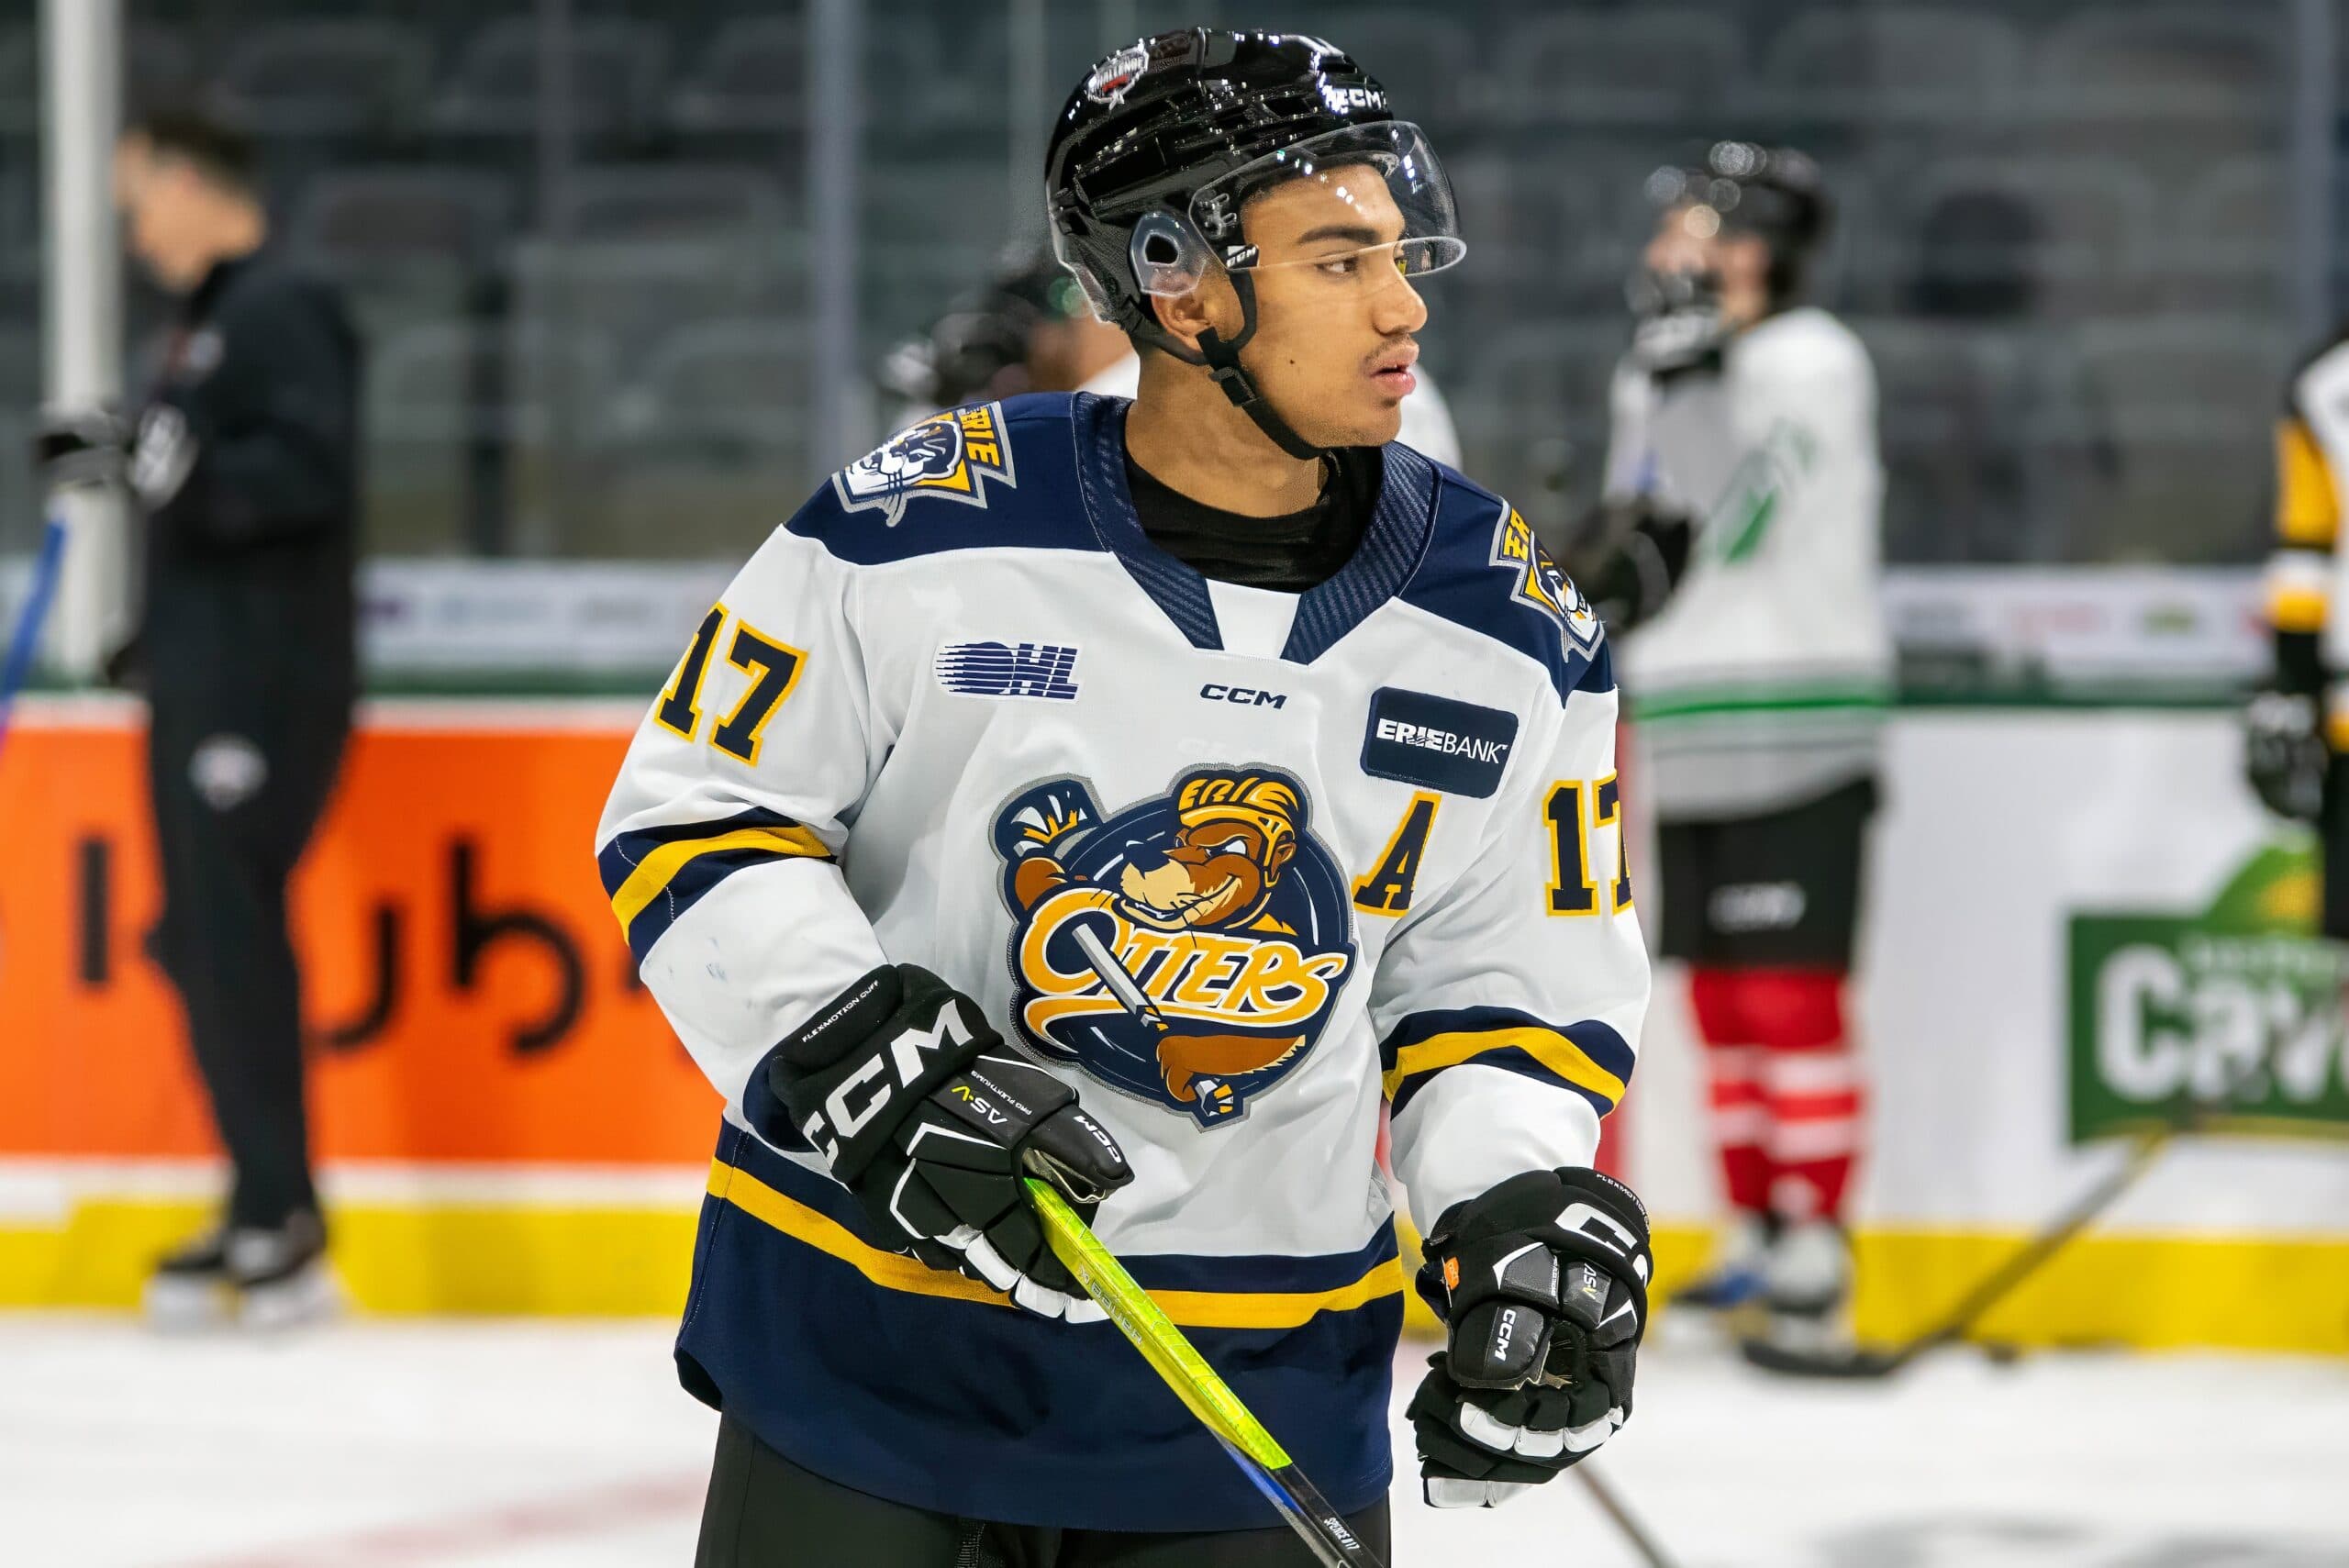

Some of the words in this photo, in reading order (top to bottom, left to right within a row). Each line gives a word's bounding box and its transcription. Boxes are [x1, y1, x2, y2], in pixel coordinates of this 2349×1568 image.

[1503, 507, 1531, 562] ER
[654, 602, 808, 767] 17
[935, 641, 1079, 700] OHL
[1199, 684, 1287, 709] CCM
[1178, 777, 1299, 812] ERIE
[1353, 792, 1442, 917] A
[1542, 768, 1632, 916] 17
[1021, 886, 1350, 1028] OTTERS
[801, 997, 860, 1043] FLEXMOTION
[859, 979, 879, 999] CUFF
[802, 997, 974, 1171] CCM
[1073, 1114, 1122, 1163] CCM
[1493, 1308, 1516, 1362] CCM
